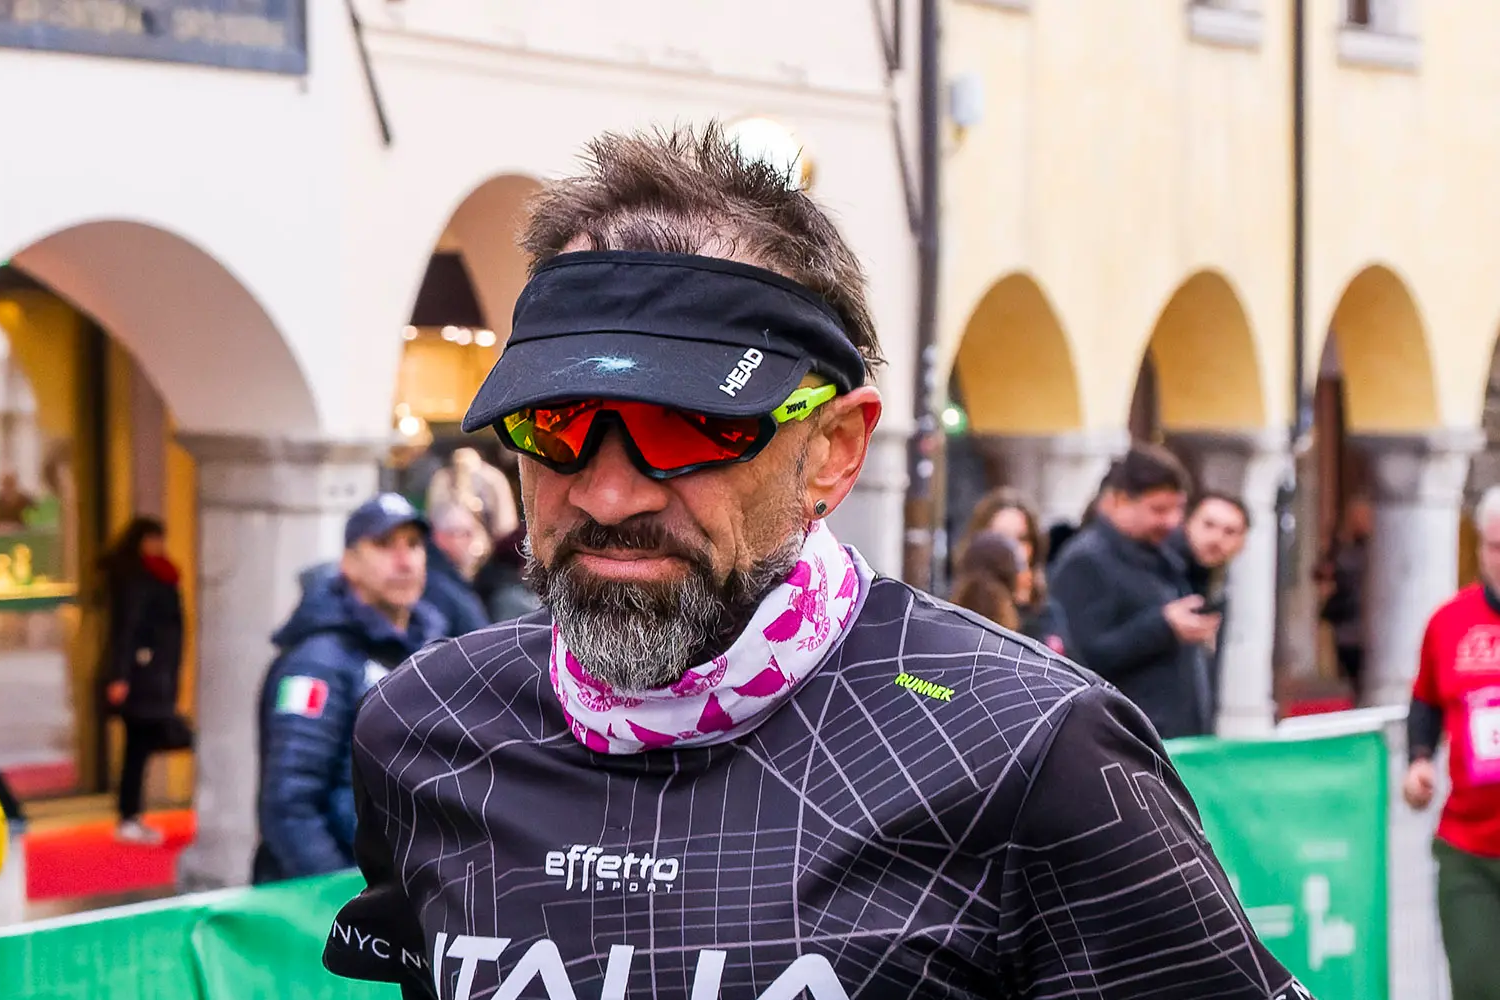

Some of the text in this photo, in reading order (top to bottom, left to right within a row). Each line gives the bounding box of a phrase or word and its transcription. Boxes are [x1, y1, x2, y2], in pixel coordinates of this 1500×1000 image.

[718, 347, 765, 398] HEAD
[894, 672, 956, 703] RUNNEK
[545, 845, 679, 892] effetto
[596, 880, 674, 893] SPORT
[332, 919, 391, 959] NYC
